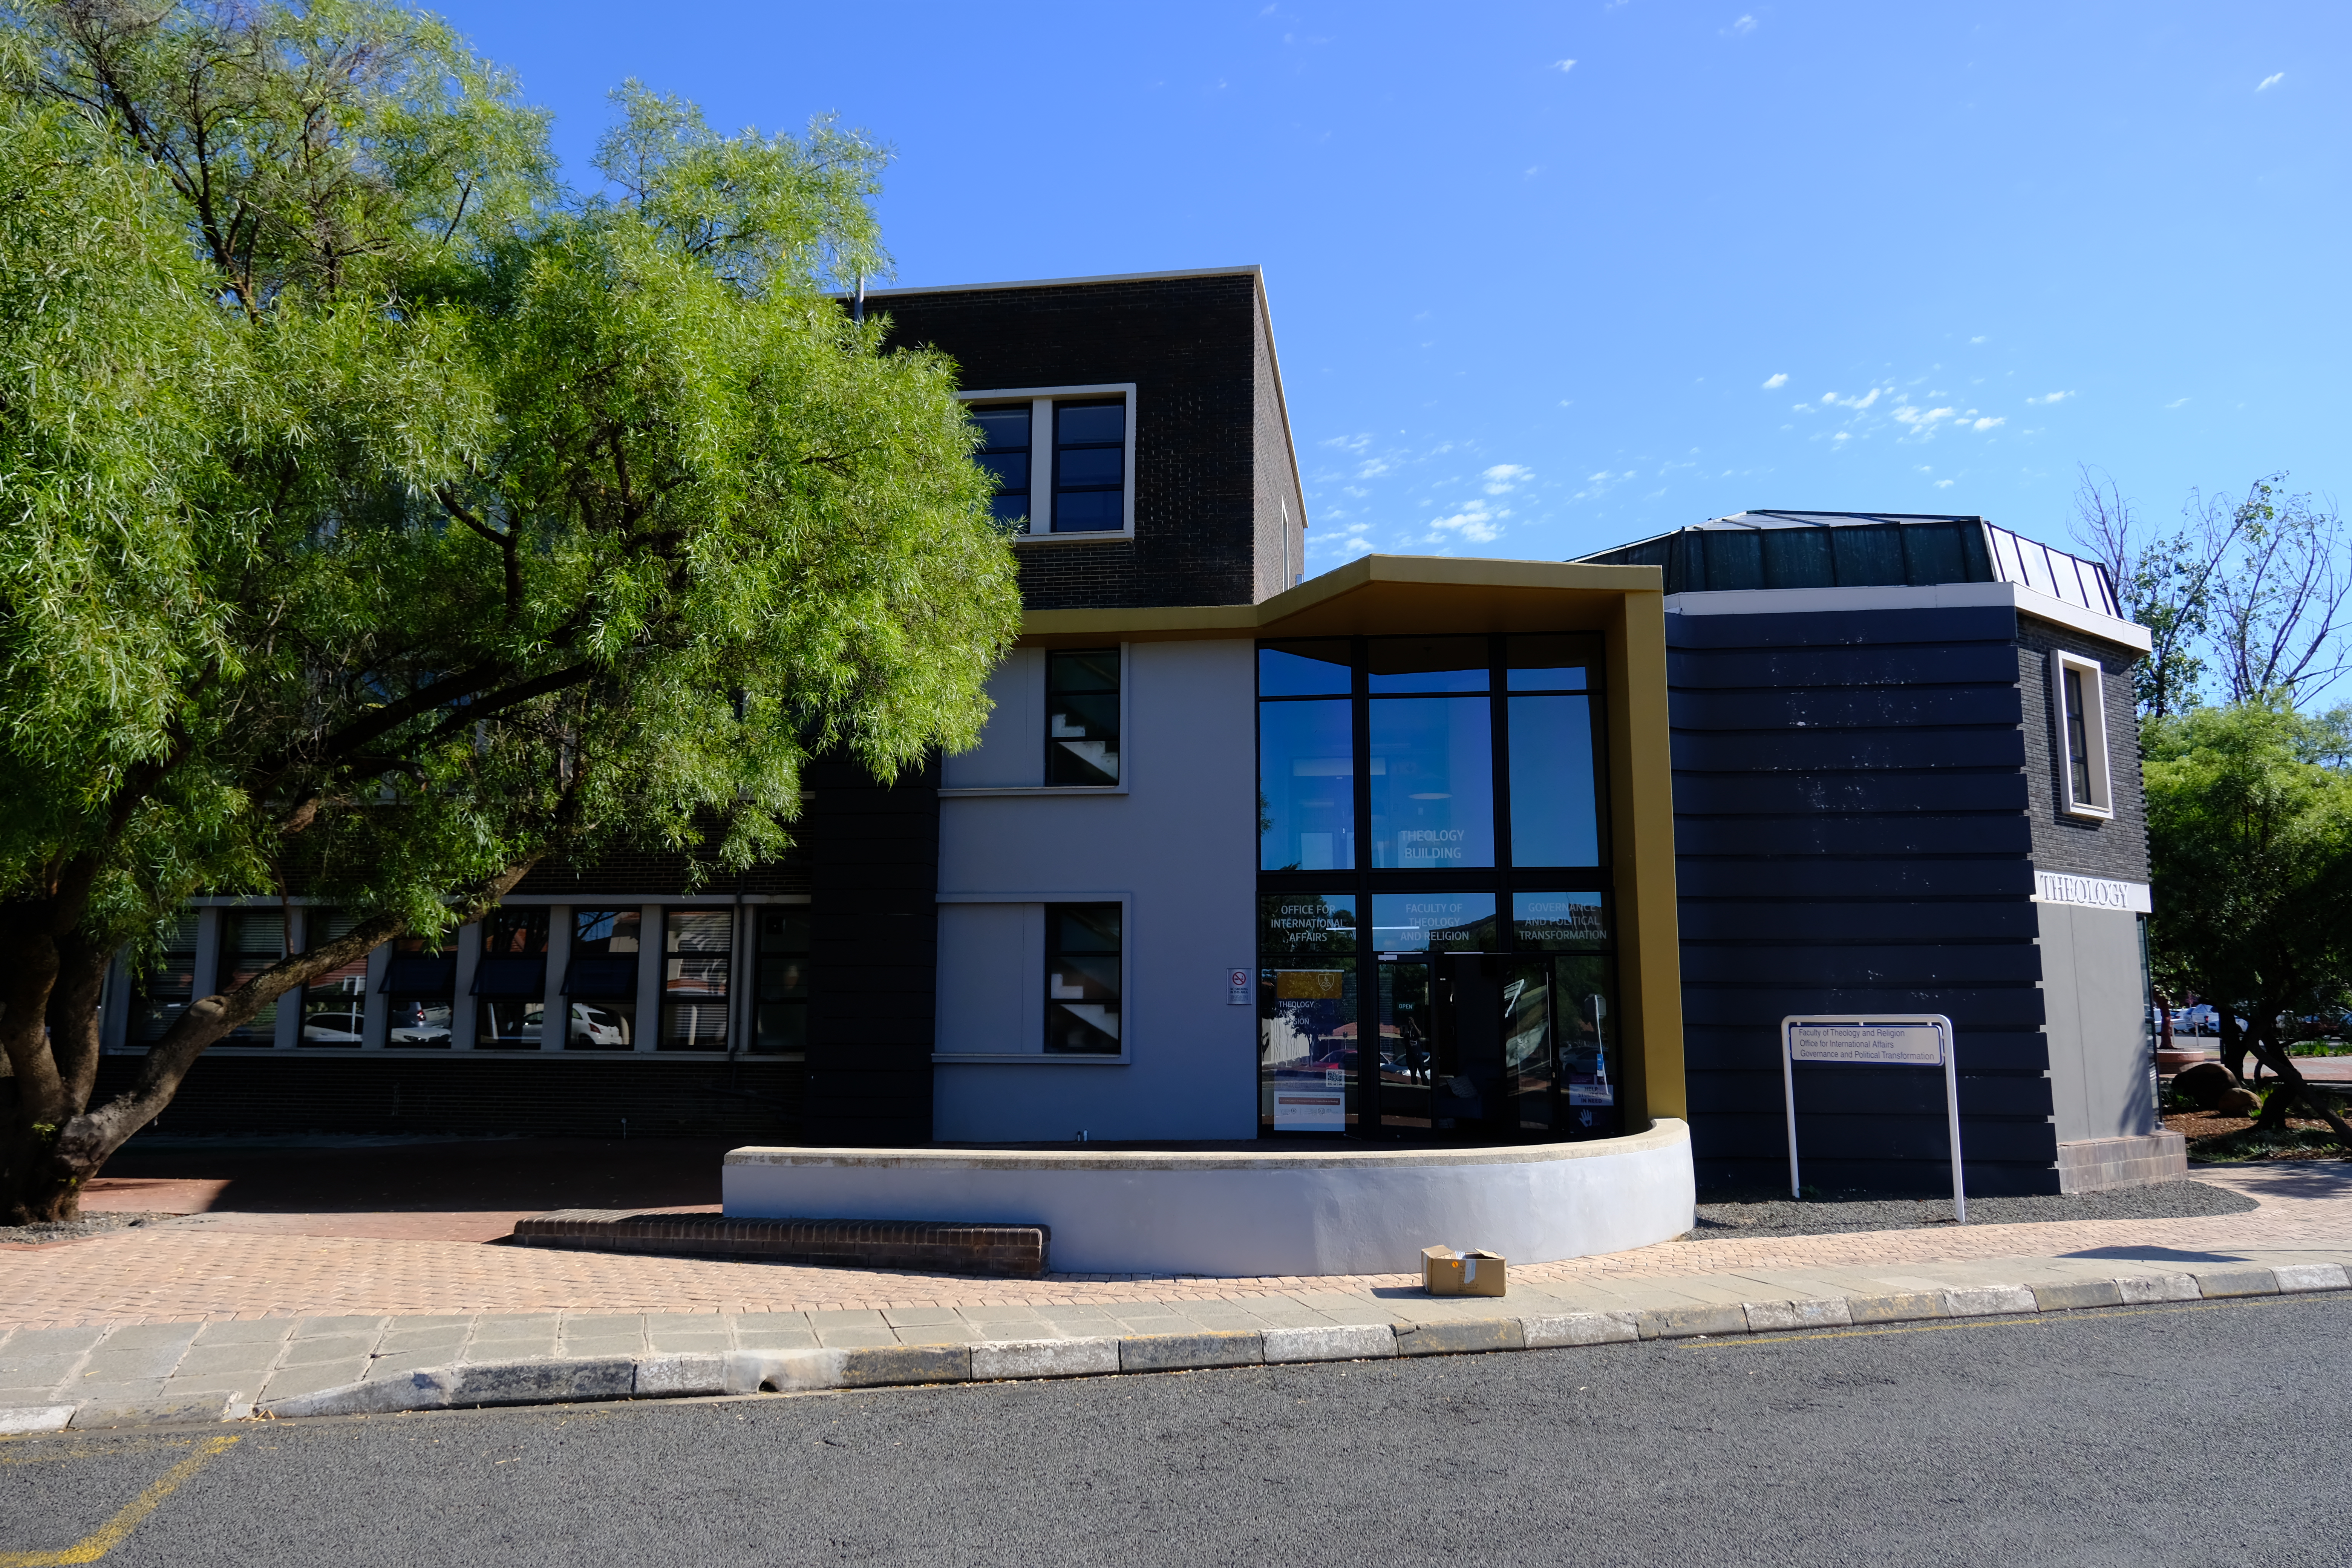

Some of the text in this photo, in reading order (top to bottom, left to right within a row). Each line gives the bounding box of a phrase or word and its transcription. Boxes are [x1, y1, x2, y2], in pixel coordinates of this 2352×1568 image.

[1401, 830, 1464, 841] THEOLOGY
[1405, 847, 1461, 859] BUILDING
[2040, 874, 2129, 908] THEOLOGY
[1281, 905, 1335, 914] OFFICE FOR
[1406, 903, 1462, 913] FACULTY OF
[1528, 902, 1596, 912] GOVERNANCE
[1271, 919, 1346, 928] INTERNATIONAL
[1409, 917, 1461, 926] THEOLOGY
[1525, 916, 1600, 926] AND POLITICAL
[1289, 932, 1327, 942] AFFAIRS
[1400, 931, 1469, 941] AND RELIGION
[1519, 930, 1607, 940] TRANSFORMATION
[1799, 1028, 1821, 1038] Faculty
[1830, 1029, 1860, 1038] Theology
[1877, 1029, 1905, 1038] Religion
[1801, 1049, 1838, 1058] Governance
[1881, 1051, 1934, 1060] Transformation
